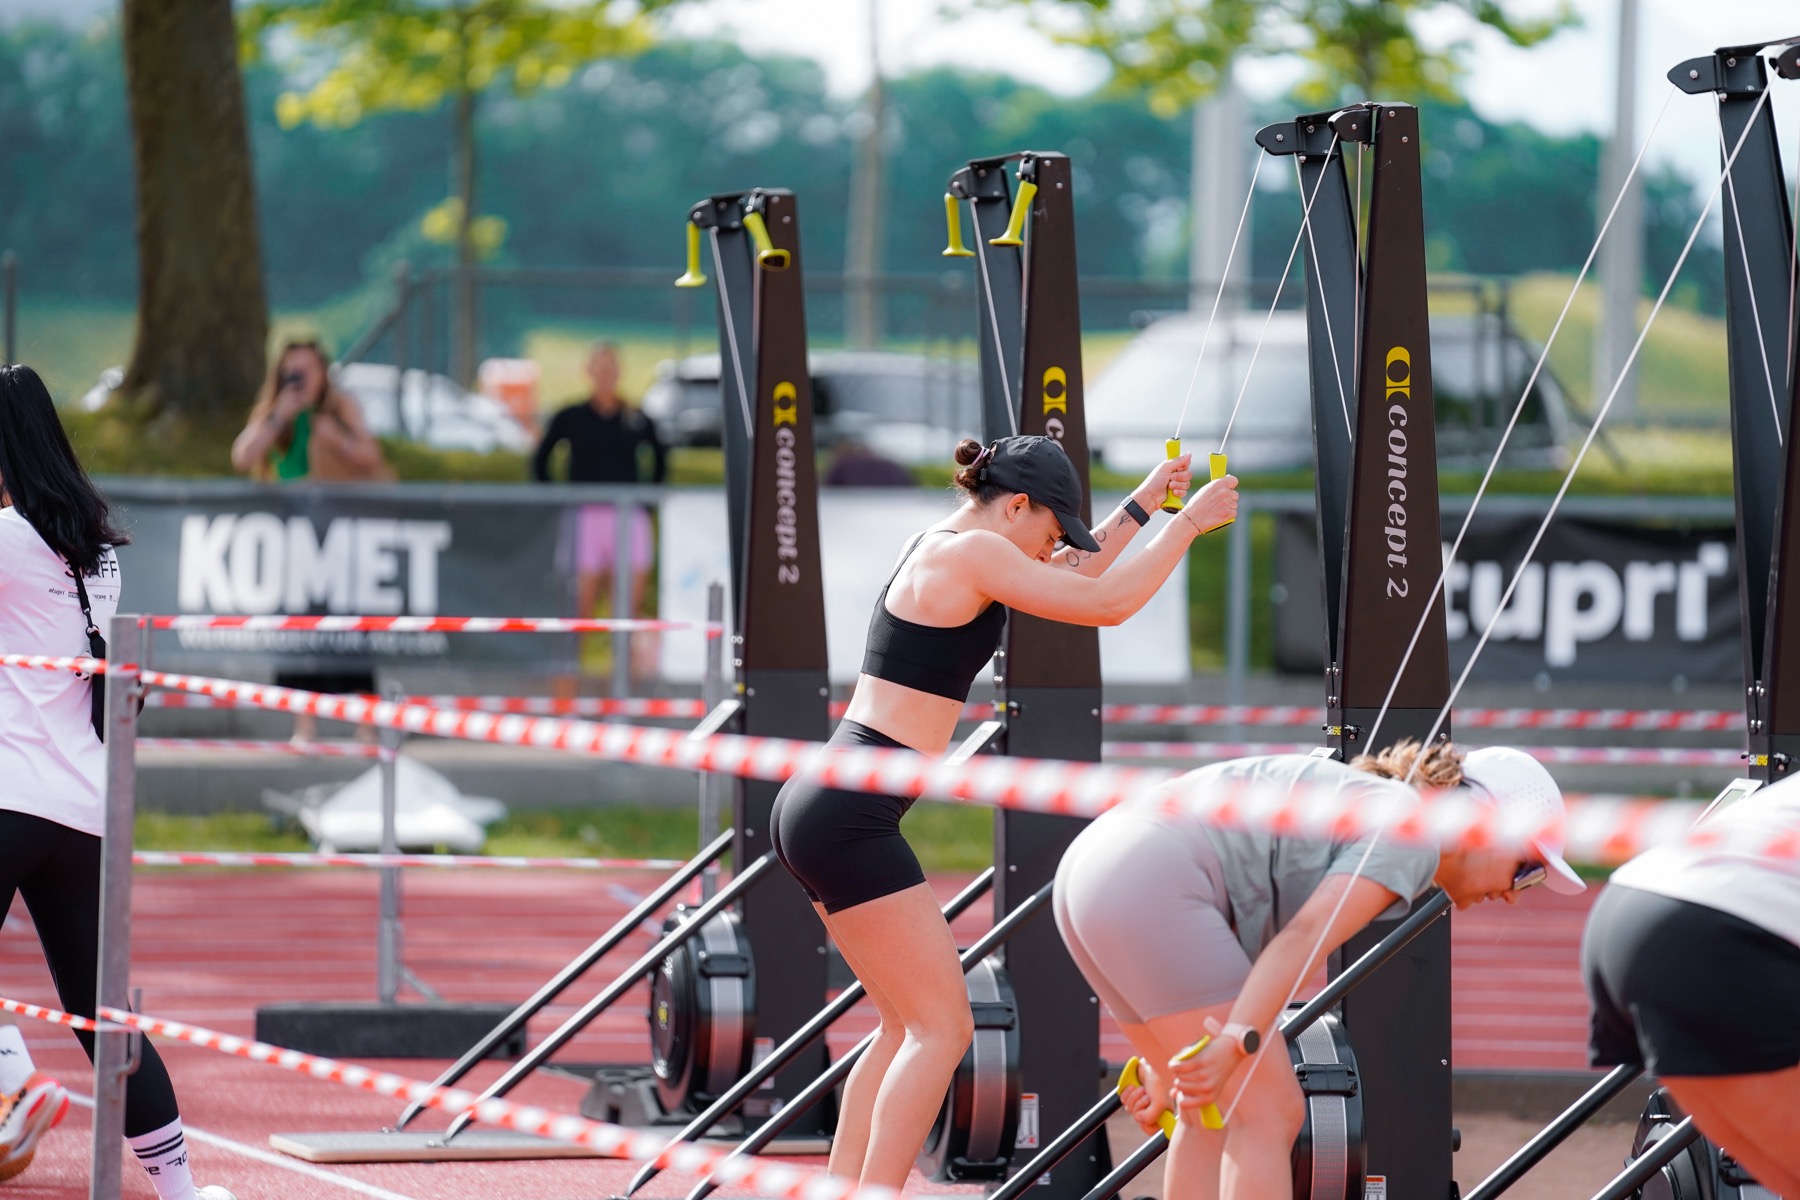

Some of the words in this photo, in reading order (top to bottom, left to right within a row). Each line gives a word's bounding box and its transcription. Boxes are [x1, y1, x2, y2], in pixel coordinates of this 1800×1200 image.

[775, 427, 798, 560] concept
[1385, 404, 1408, 568] concept
[178, 512, 453, 616] KOMET
[778, 564, 800, 584] 2
[1386, 577, 1408, 598] 2
[1442, 541, 1729, 667] tupri
